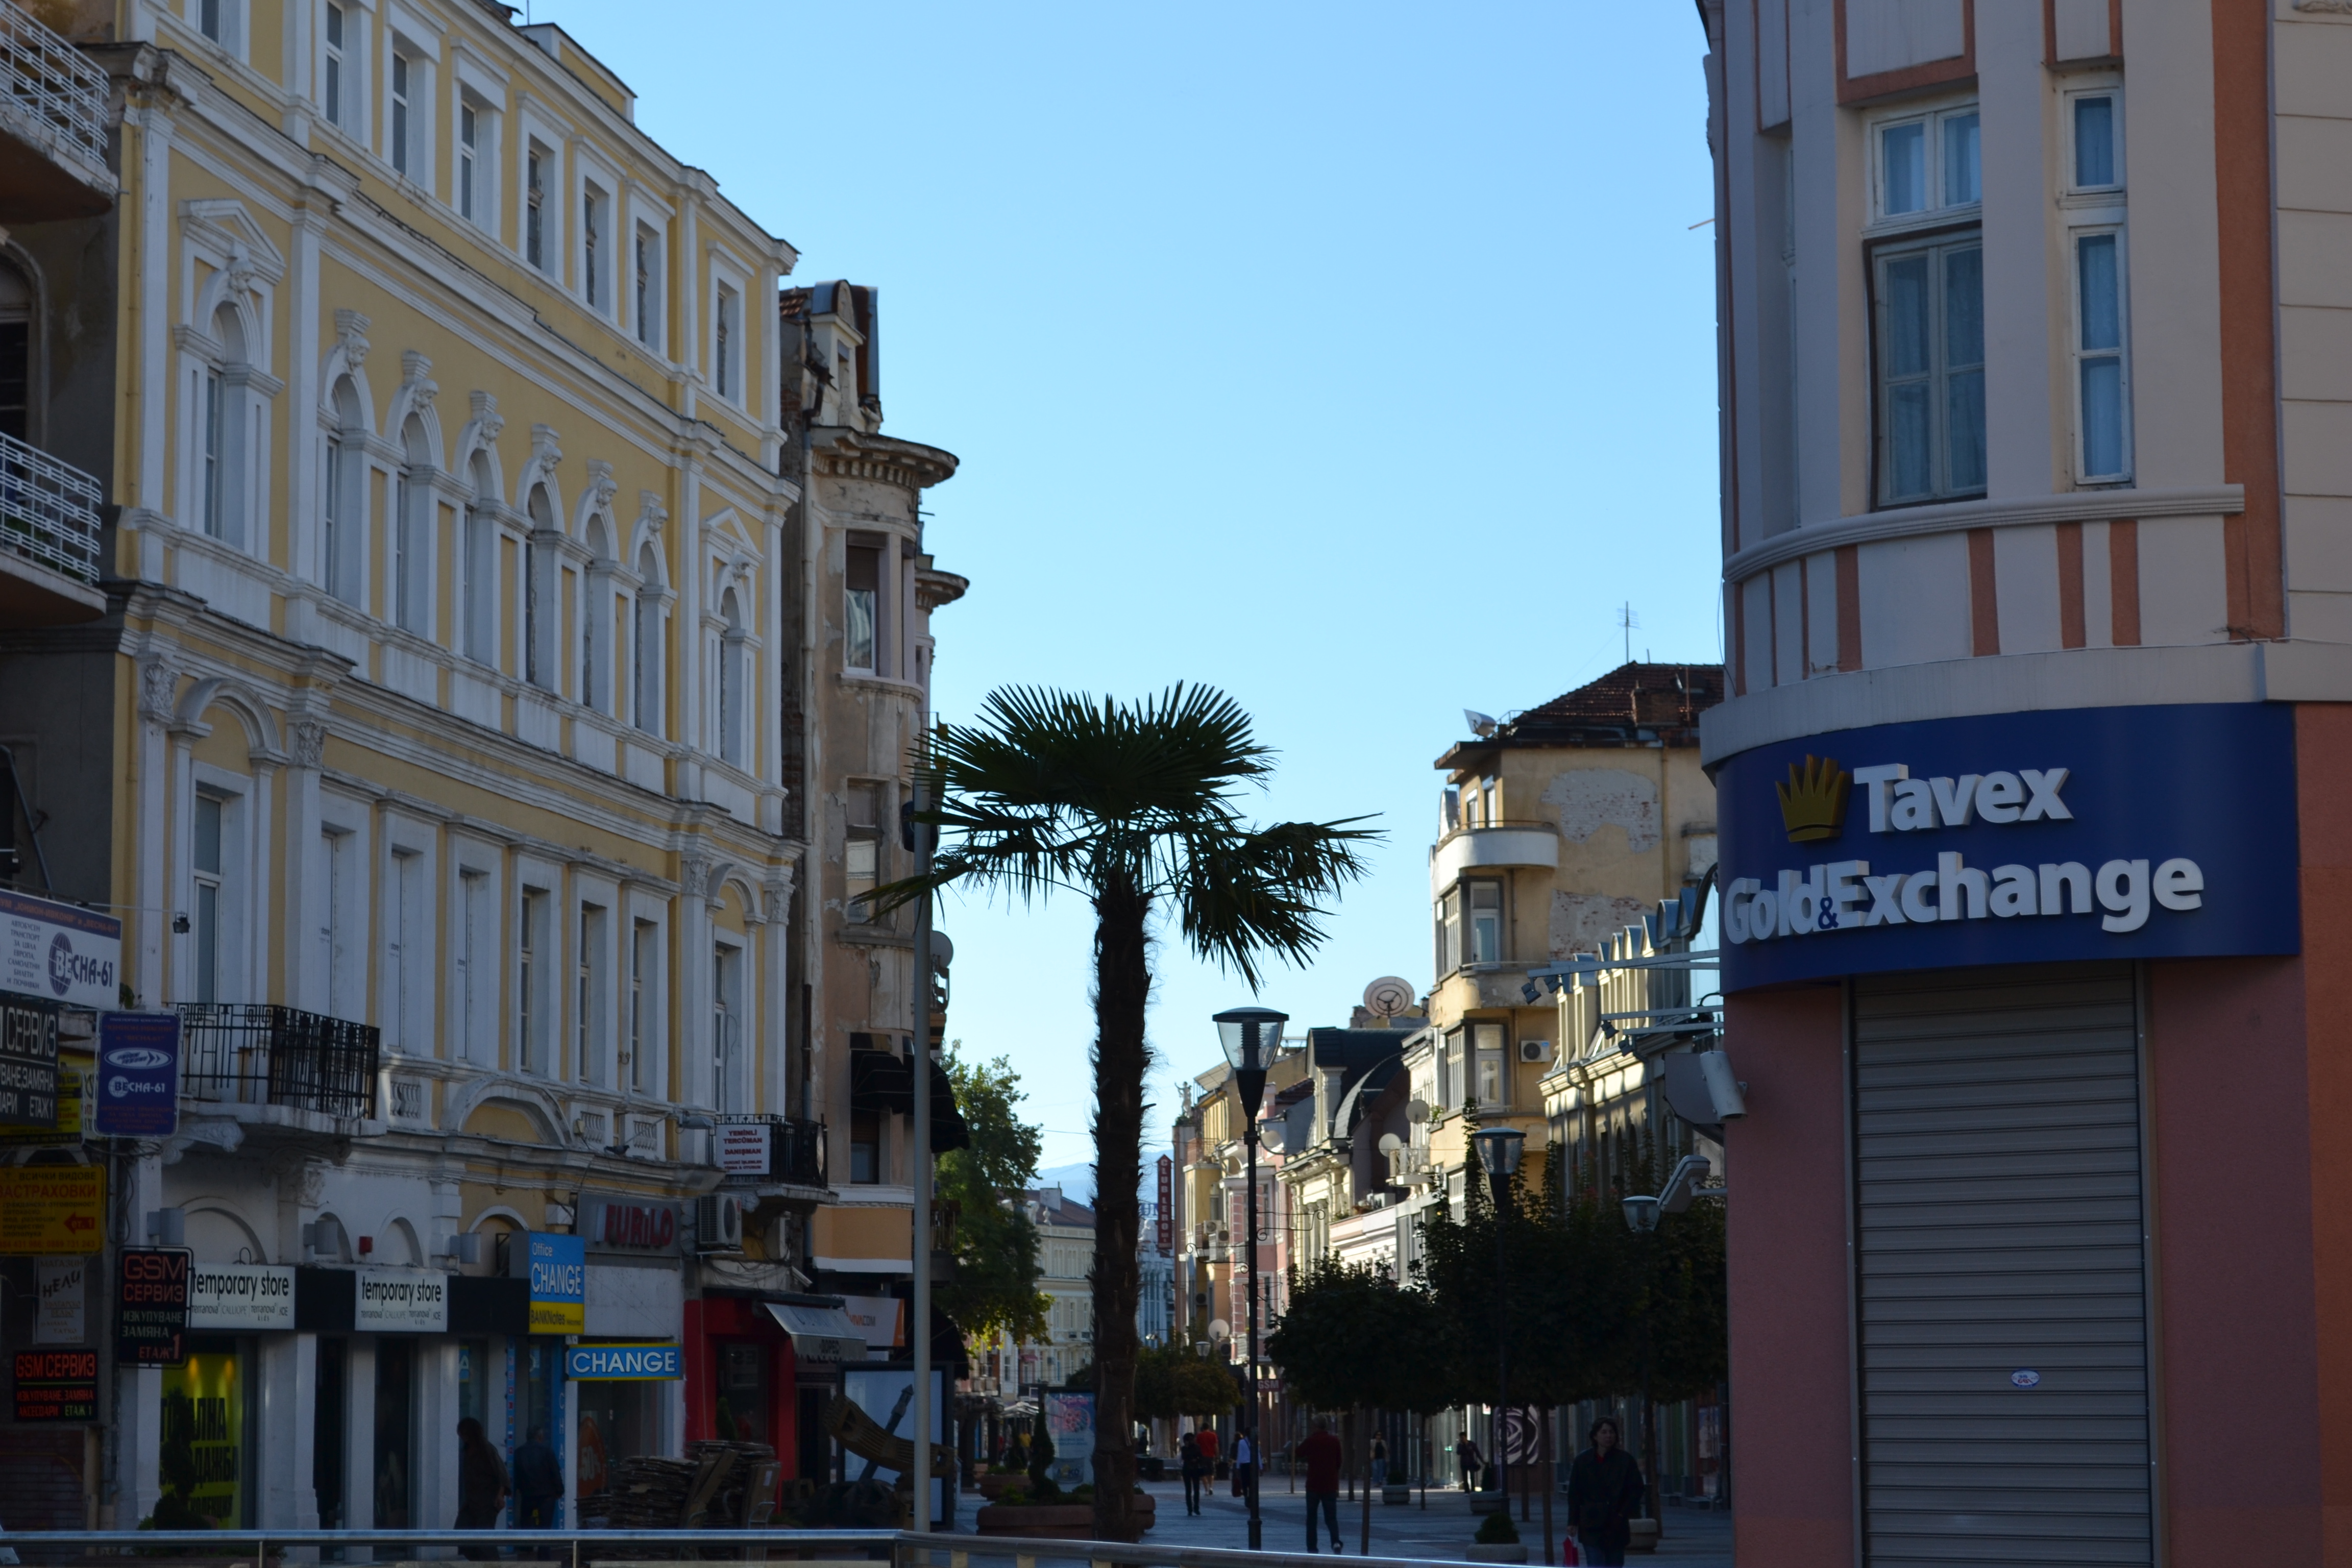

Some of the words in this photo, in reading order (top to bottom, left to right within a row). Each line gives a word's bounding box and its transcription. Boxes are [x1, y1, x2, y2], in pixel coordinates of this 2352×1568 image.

[1854, 763, 2073, 833] Tavex
[11, 920, 40, 932] АВТОБУСЕН
[10, 929, 40, 941] ТРАНСПОРТ
[14, 940, 20, 948] ЗА
[8, 958, 40, 970] САМОЛЕТНИ
[54, 949, 113, 987] ВЕСНА-61
[14, 969, 34, 978] БИЛЕТИ
[13, 977, 40, 989] ПОЧИВКИ
[7, 1007, 56, 1058] СЕРВИЗ
[114, 1082, 165, 1093] ВЕСНА-61
[29, 1095, 50, 1119] ЕТАЖ
[19, 1172, 56, 1181] ВСИЧКИ
[59, 1172, 96, 1181] ВИДОВЕ
[532, 1242, 553, 1257] Office
[40, 1259, 83, 1267] МАГАЗИН
[124, 1255, 185, 1280] GSM
[191, 1271, 257, 1301] temporary
[261, 1270, 289, 1296] store
[531, 1262, 582, 1295] CHANGE
[124, 1284, 184, 1302] СЕРВИЗ
[362, 1276, 414, 1307] temporary
[417, 1279, 442, 1302] store
[122, 1310, 183, 1324] ИЗКУПУВАНЕ
[121, 1326, 169, 1338] ЗАМЯНА
[138, 1346, 170, 1360] ЕТАЖ
[173, 1333, 181, 1360] 1
[16, 1355, 43, 1378] GSM
[46, 1354, 95, 1377] СЕРВИЗ
[572, 1352, 676, 1373] CHANGE
[1257, 1379, 1279, 1389] GSM
[65, 1389, 94, 1401] ЗАМЯНА
[65, 1405, 86, 1416] ЕТАЖ
